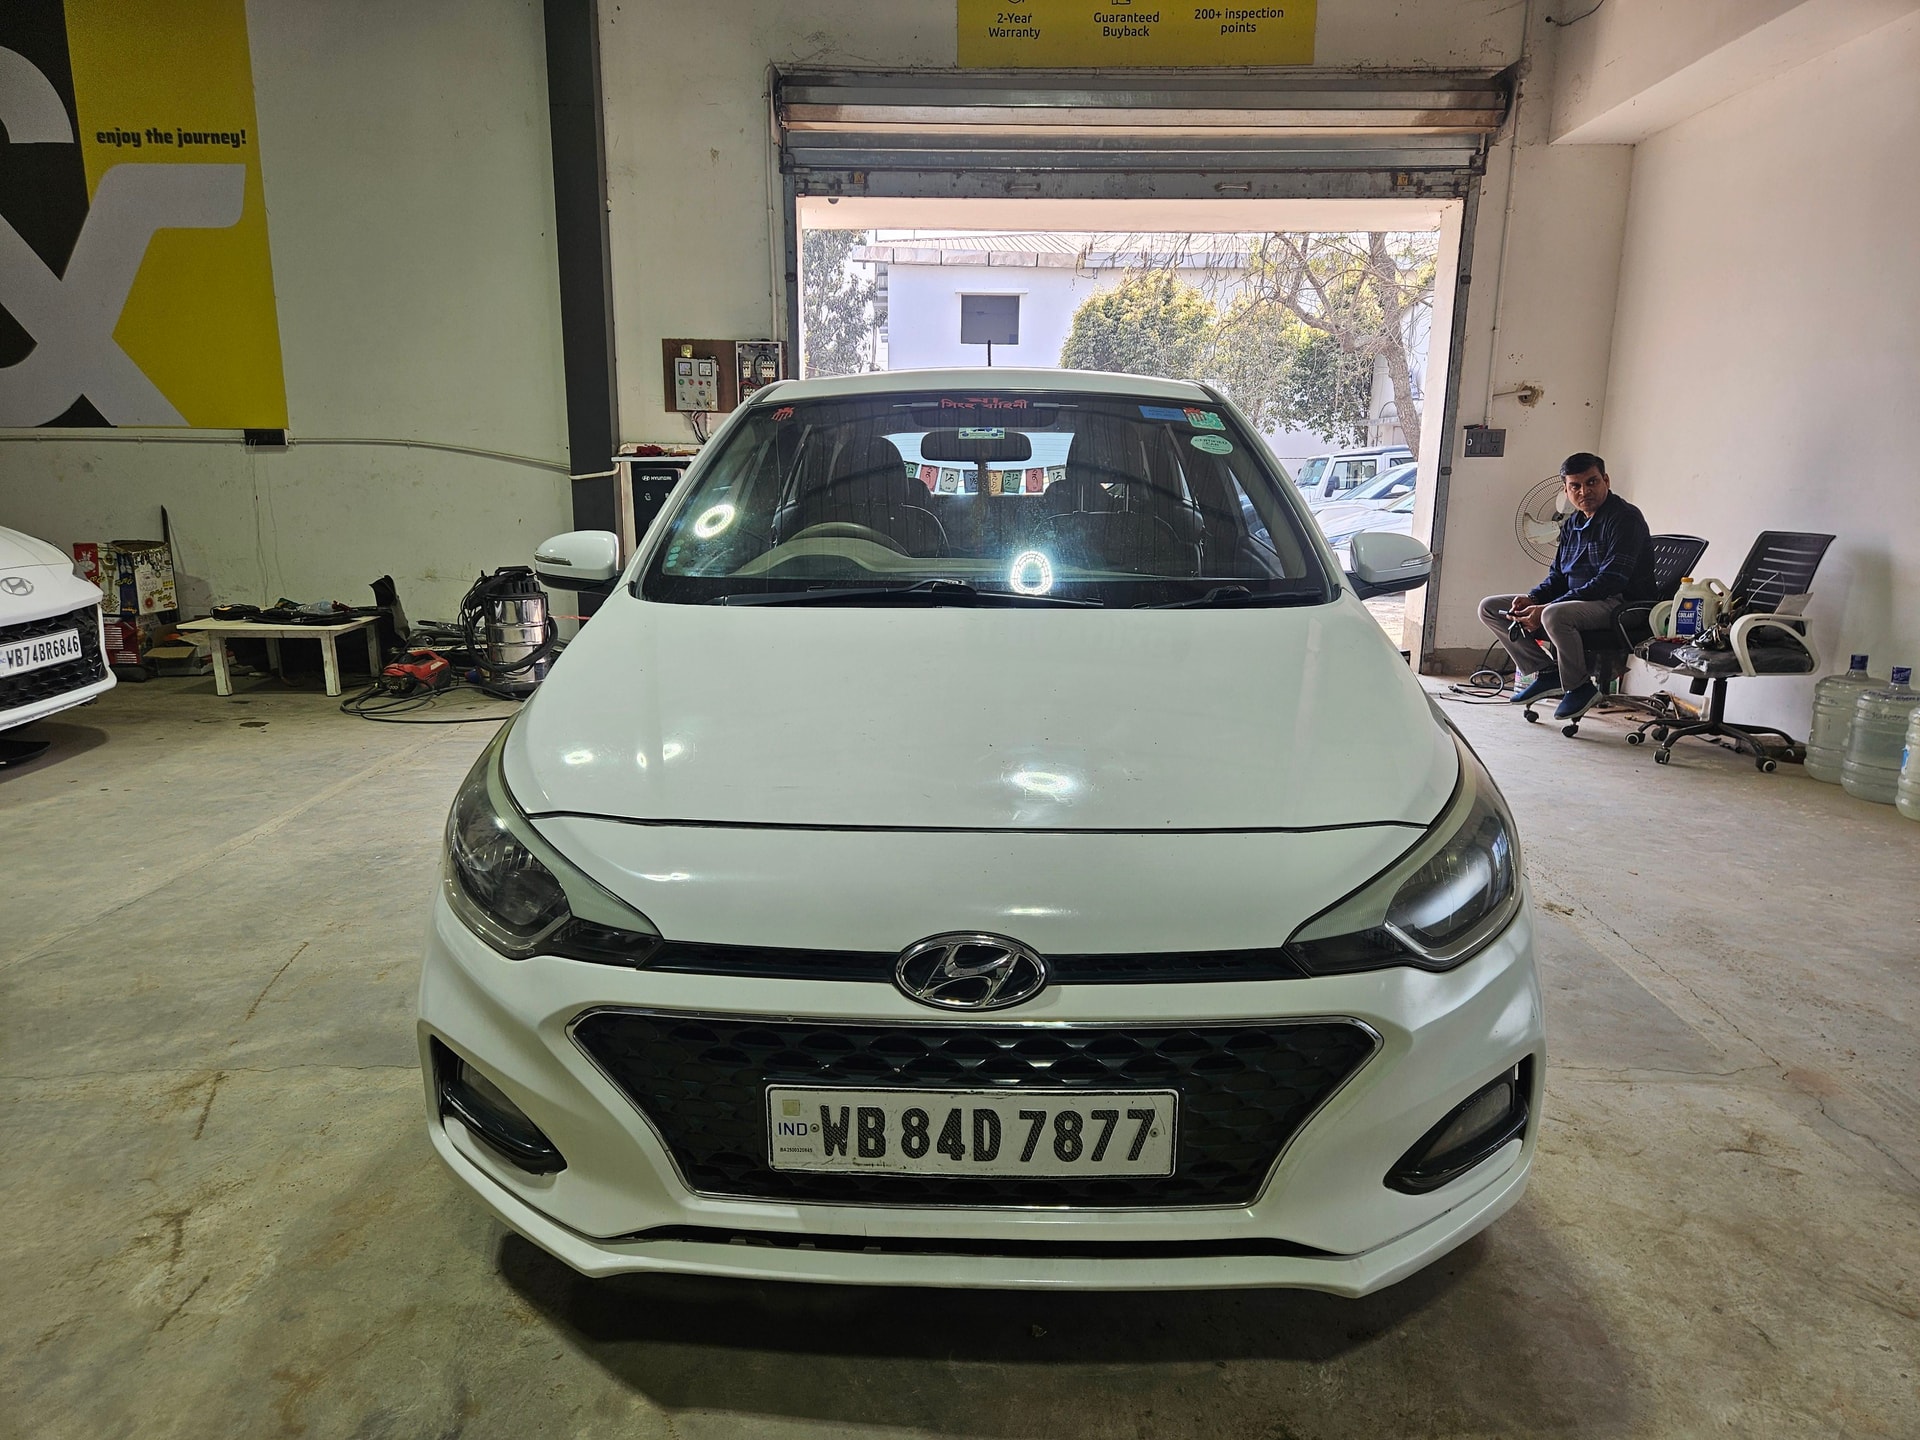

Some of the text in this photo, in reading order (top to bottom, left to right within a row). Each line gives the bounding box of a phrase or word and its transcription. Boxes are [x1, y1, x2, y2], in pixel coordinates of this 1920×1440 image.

[997, 13, 1033, 24] 2-Year
[1093, 12, 1160, 23] Guaranteed
[1194, 7, 1284, 21] 200+ inspection
[988, 27, 1041, 40] Warranty
[1102, 26, 1150, 39] Buyback
[1220, 22, 1257, 35] points
[96, 127, 247, 149] enjoy the journey!
[6, 635, 79, 669] WB74BR6846
[778, 1105, 1156, 1163] IND WB 84D 7877
